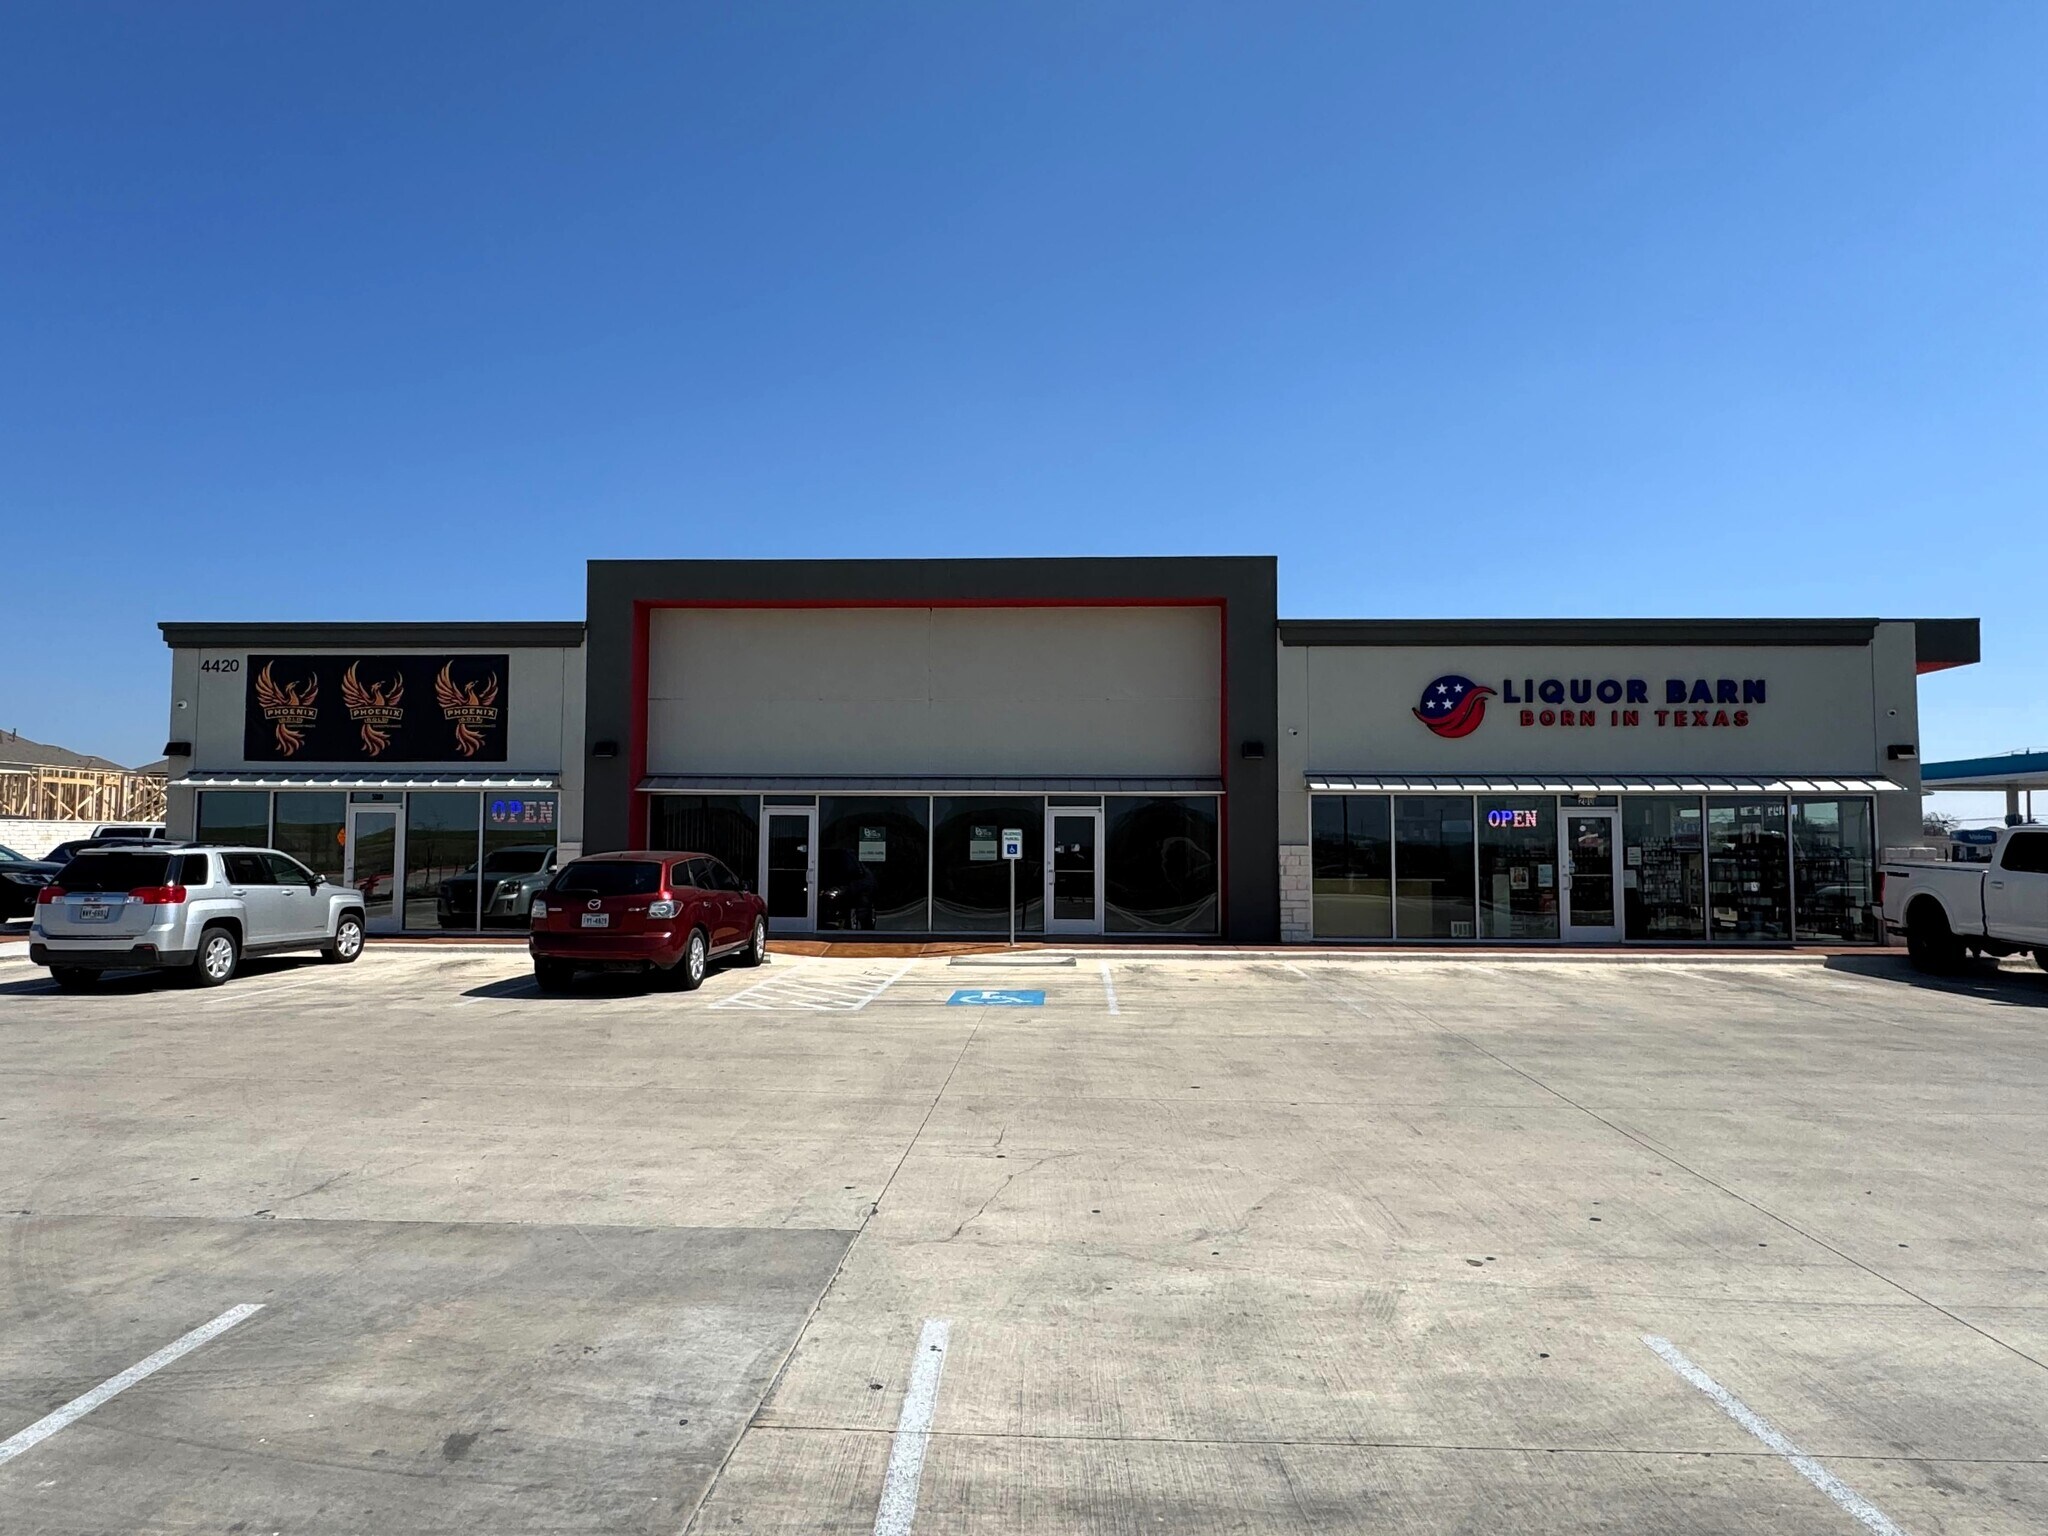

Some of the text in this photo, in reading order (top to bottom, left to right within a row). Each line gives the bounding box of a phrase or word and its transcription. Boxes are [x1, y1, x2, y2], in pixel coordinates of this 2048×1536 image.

[201, 659, 239, 672] 4420
[1503, 679, 1766, 704] LIQUOR BARN
[267, 708, 315, 716] PHOENIX
[353, 708, 401, 716] PHOENIX
[447, 708, 495, 716] PHOENIX
[1520, 710, 1749, 727] BORN IN TEXAS
[491, 800, 554, 823] OPEN
[1488, 810, 1537, 827] OPEN
